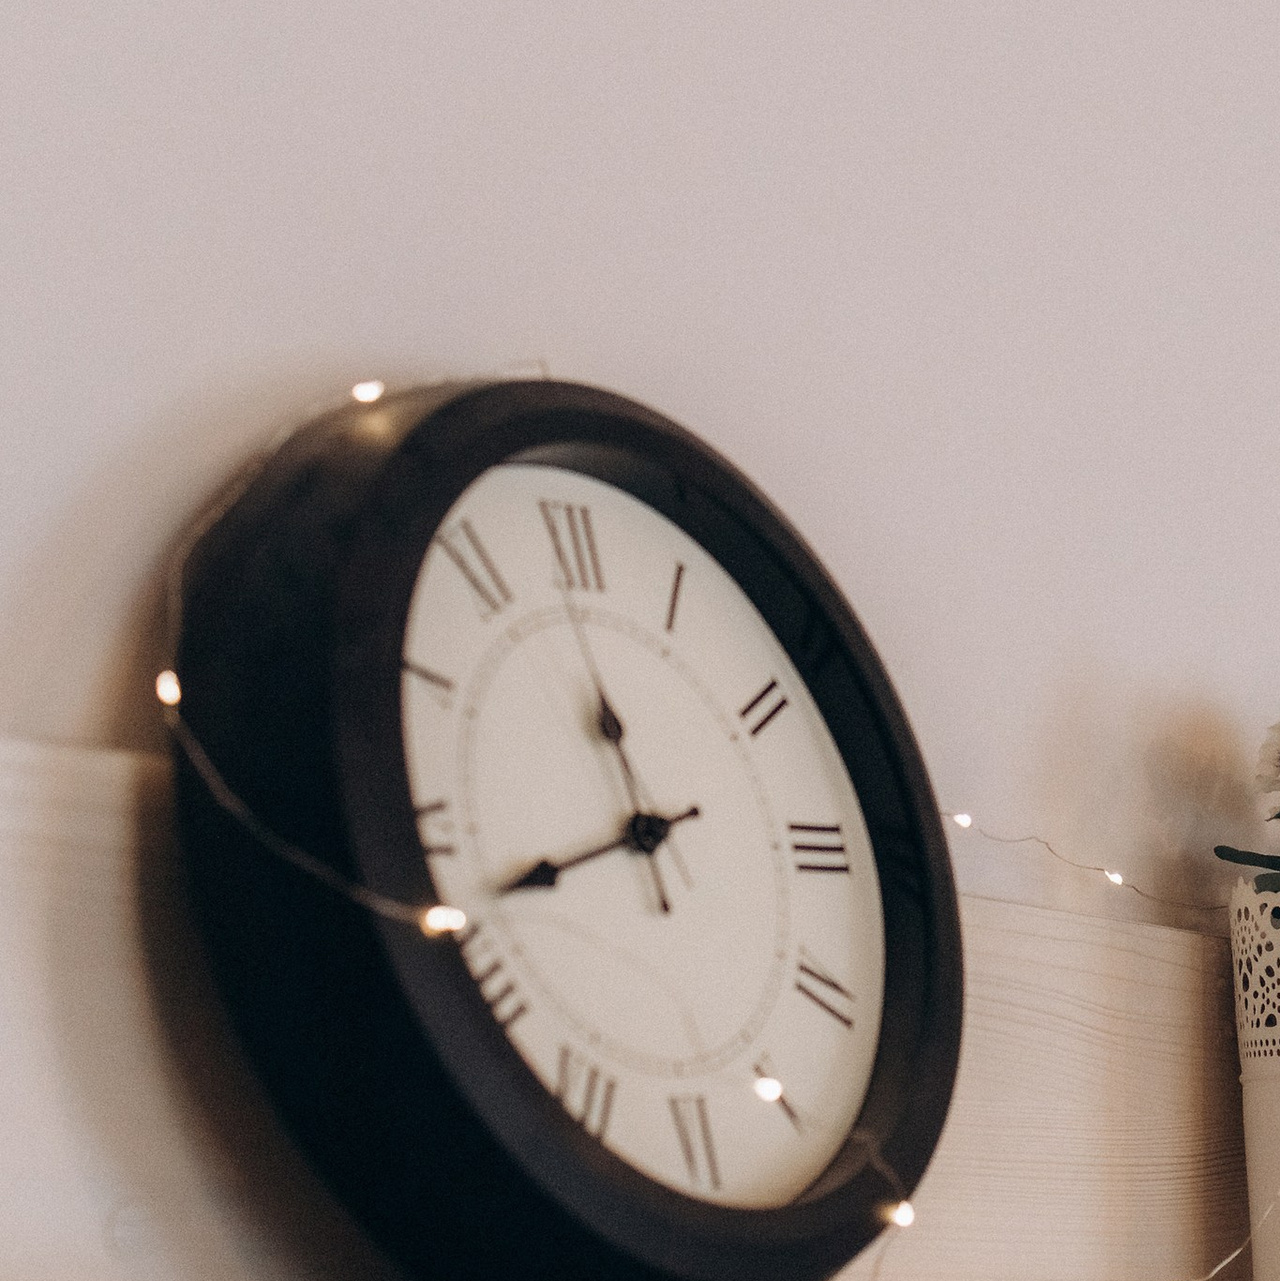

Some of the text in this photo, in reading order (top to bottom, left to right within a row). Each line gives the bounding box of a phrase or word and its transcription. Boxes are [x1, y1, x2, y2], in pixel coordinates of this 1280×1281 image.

[433, 516, 513, 622] XI
[538, 498, 606, 594] XII
[666, 563, 685, 632] I
[739, 678, 789, 736] II
[788, 822, 850, 873] III
[795, 945, 856, 1029] IV
[668, 1094, 721, 1190] VI
